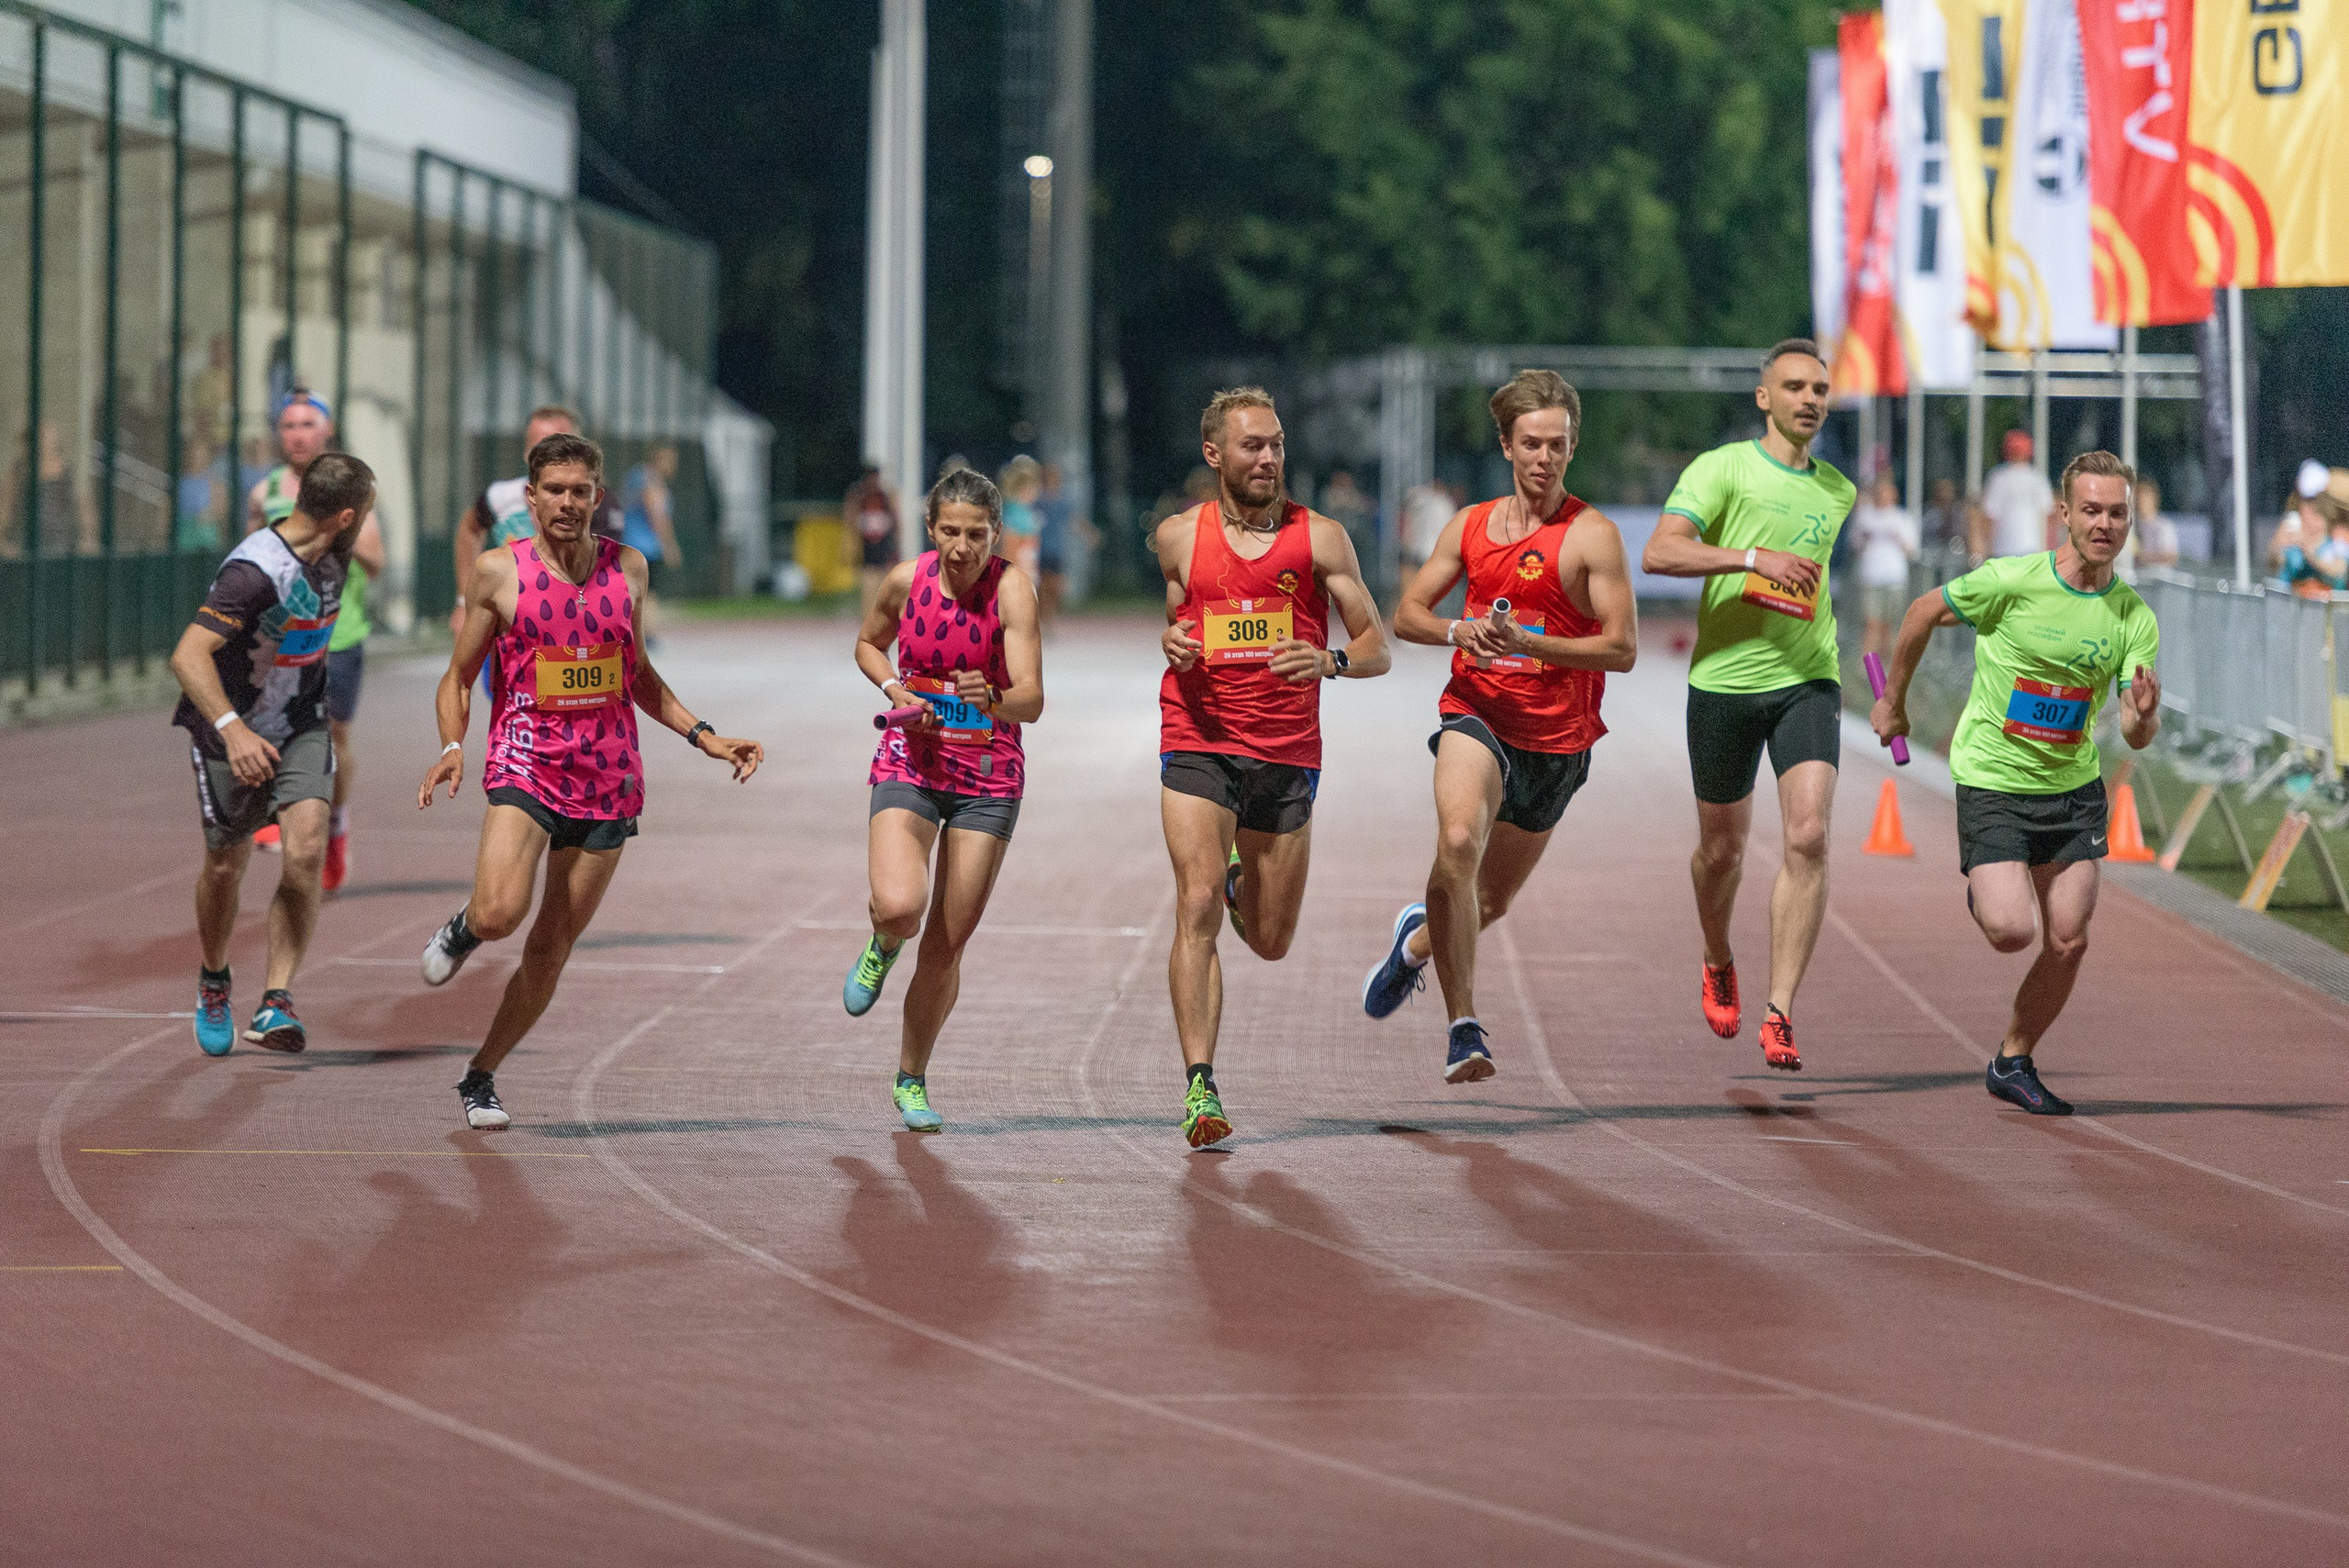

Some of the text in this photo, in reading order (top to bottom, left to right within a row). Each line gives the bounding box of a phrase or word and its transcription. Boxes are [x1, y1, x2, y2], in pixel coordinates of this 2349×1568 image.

[1228, 619, 1268, 641] 308
[562, 666, 615, 689] 309 2
[933, 699, 983, 723] 309 3
[2032, 702, 2069, 724] 307
